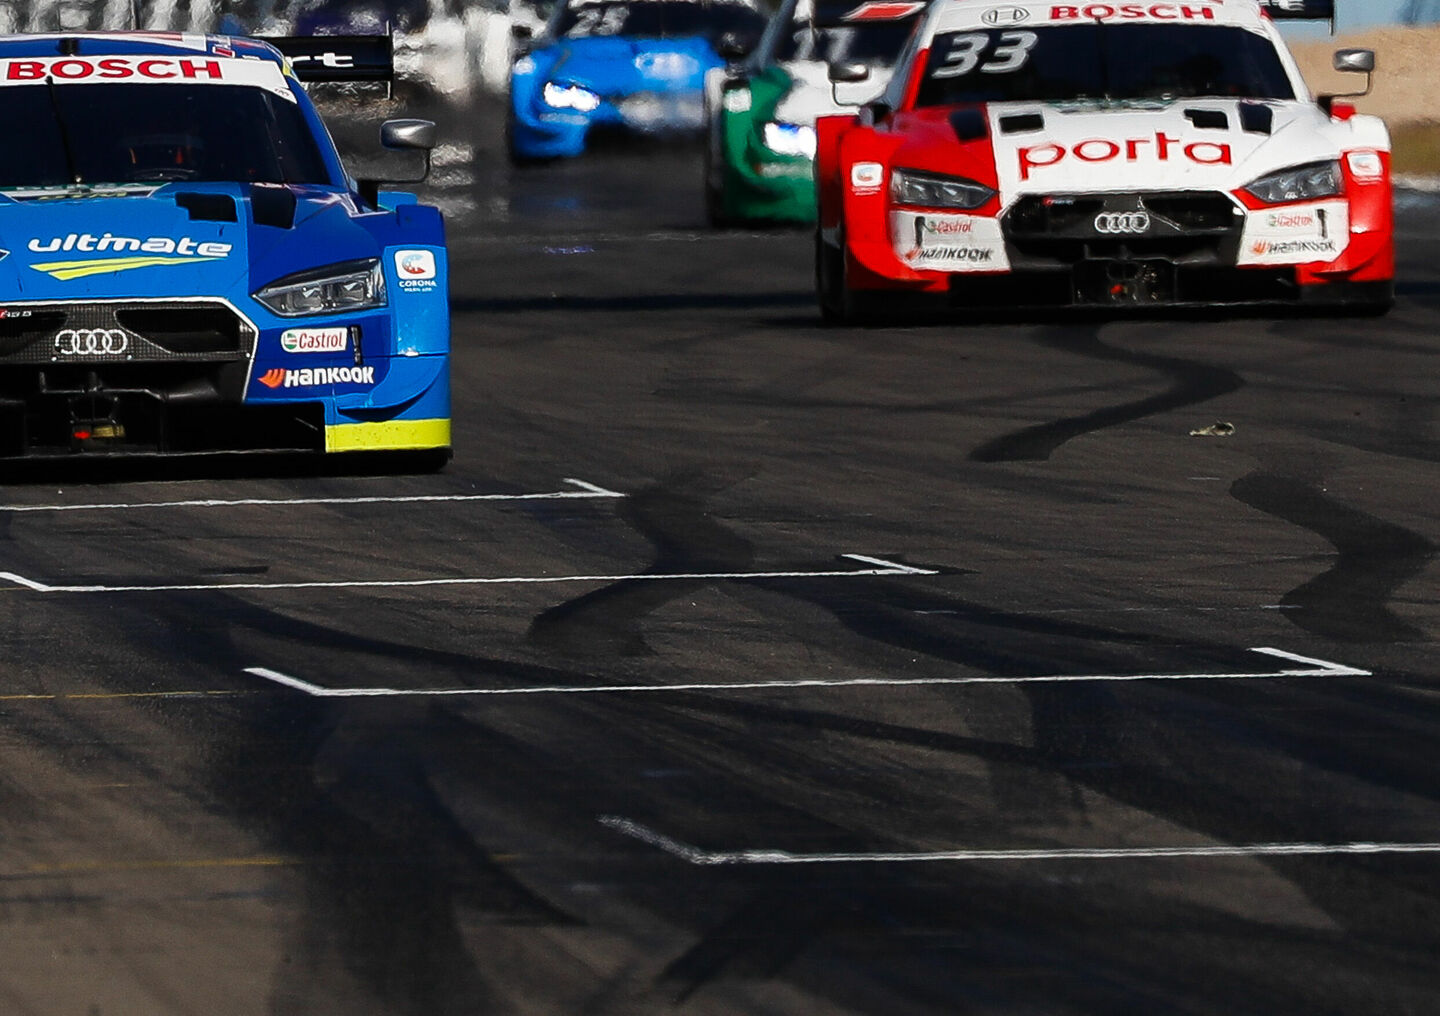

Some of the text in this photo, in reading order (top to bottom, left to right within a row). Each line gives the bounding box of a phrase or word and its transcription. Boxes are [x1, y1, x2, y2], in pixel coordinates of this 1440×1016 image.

[1050, 4, 1215, 21] BOSCH
[932, 31, 1038, 78] 33
[7, 59, 224, 81] BOSCH
[1016, 131, 1233, 182] porta
[27, 233, 233, 258] ultimate
[298, 333, 344, 349] Castrol
